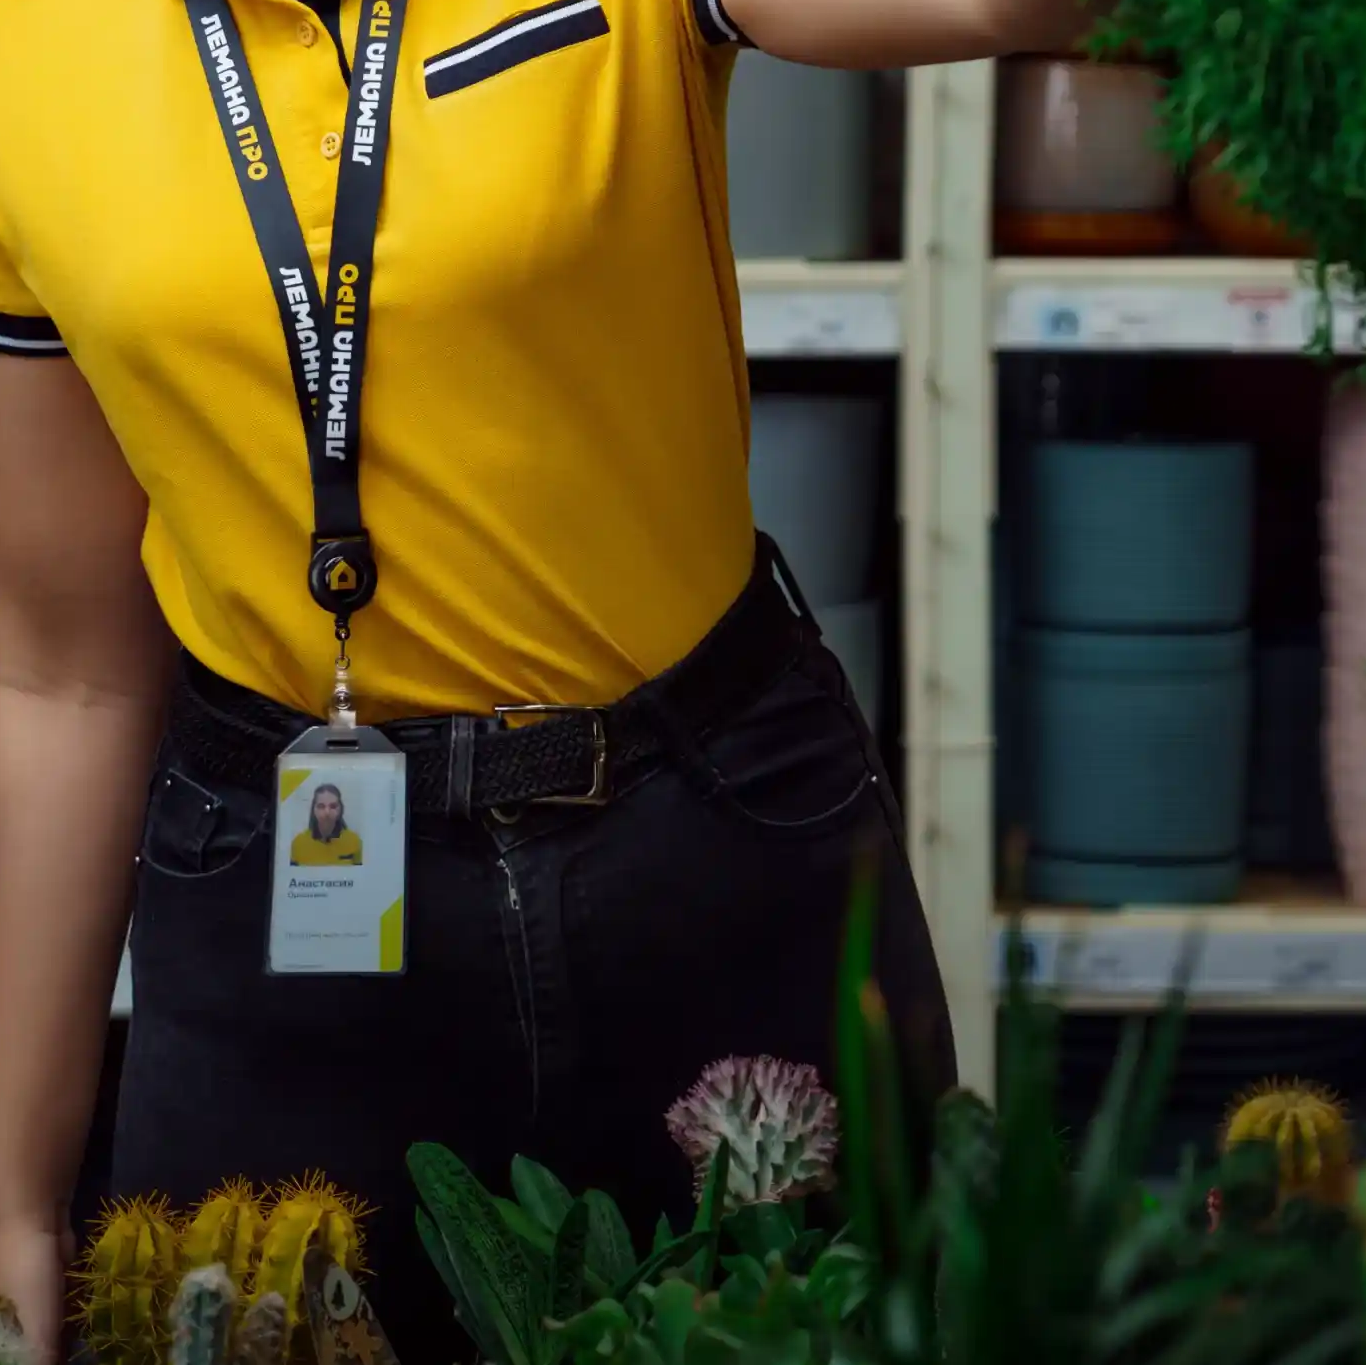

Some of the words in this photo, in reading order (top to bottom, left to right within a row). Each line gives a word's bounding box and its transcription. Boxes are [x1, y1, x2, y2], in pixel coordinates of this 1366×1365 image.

[200, 14, 251, 126] ЛЕМАНА
[237, 125, 269, 181] ПРО
[352, 42, 388, 166] ЛЕМАНА
[335, 263, 359, 325] ПРО
[326, 330, 354, 460] ЛЕМАНА
[288, 877, 354, 889] Анастасия
